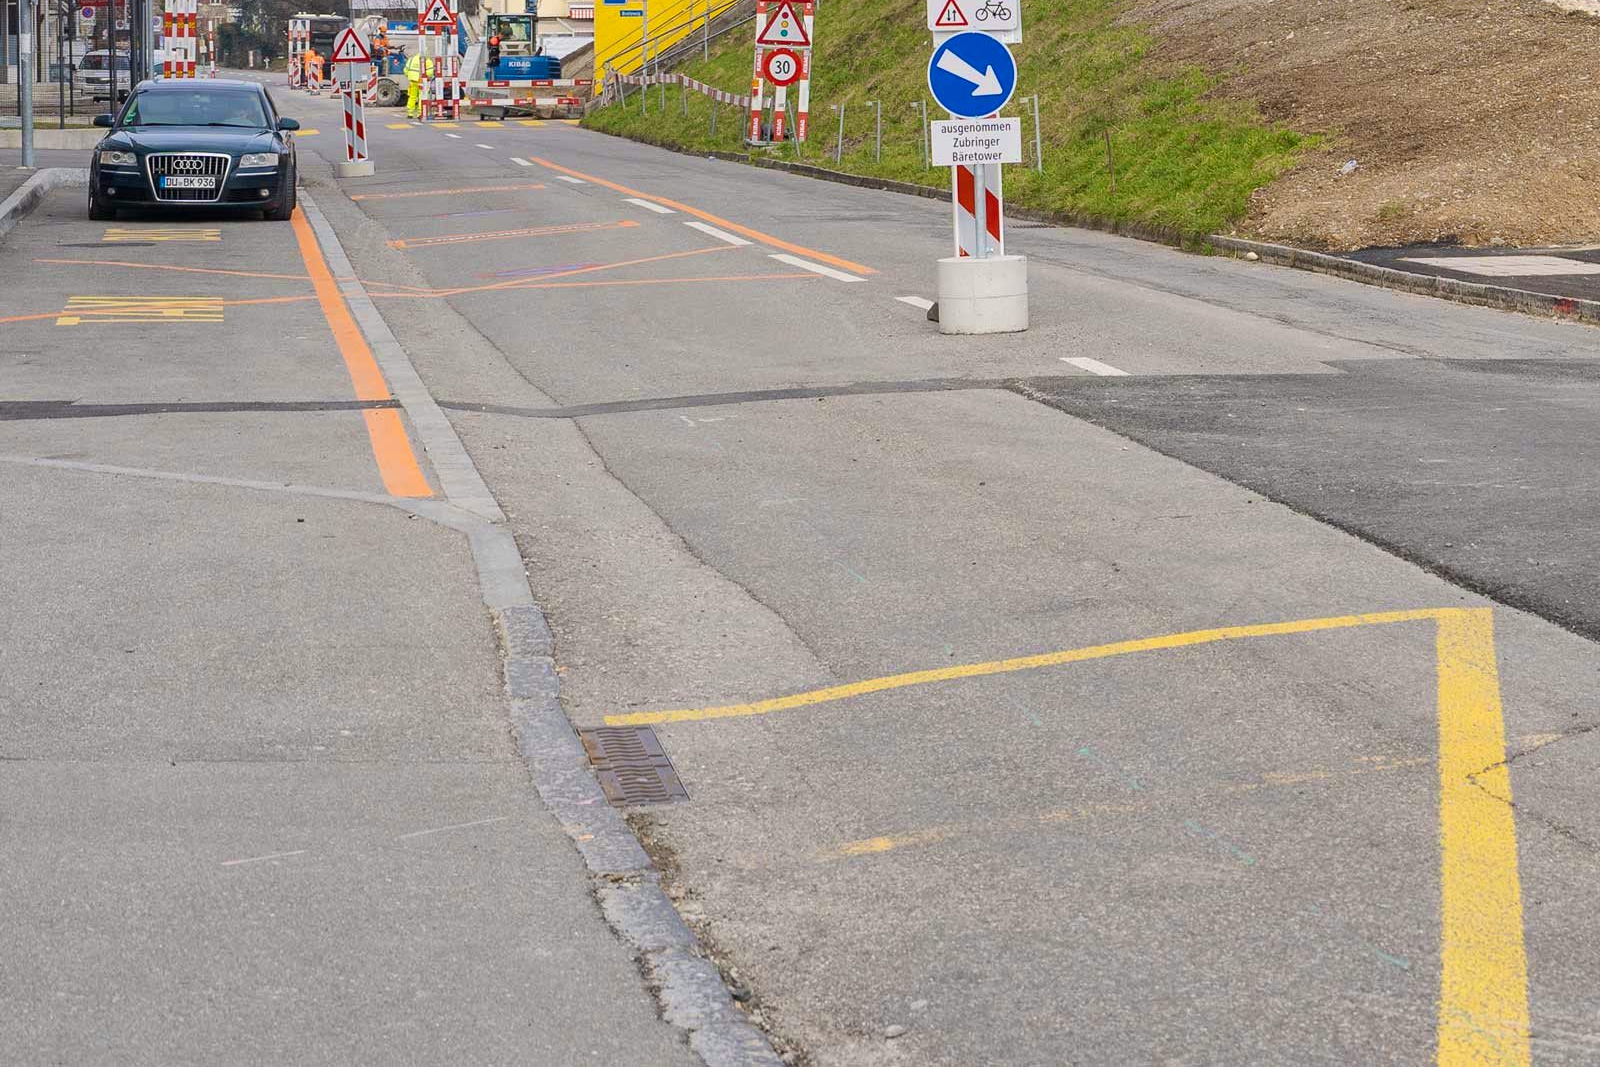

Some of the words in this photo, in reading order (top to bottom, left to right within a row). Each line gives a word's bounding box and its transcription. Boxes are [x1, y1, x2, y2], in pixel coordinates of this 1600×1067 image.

[775, 61, 790, 74] 30
[941, 122, 1011, 135] ausgenommen
[953, 136, 1000, 149] Zubringer
[952, 151, 1002, 162] Bäretower
[166, 178, 178, 186] DU
[183, 178, 196, 186] BK
[197, 178, 214, 187] 936
